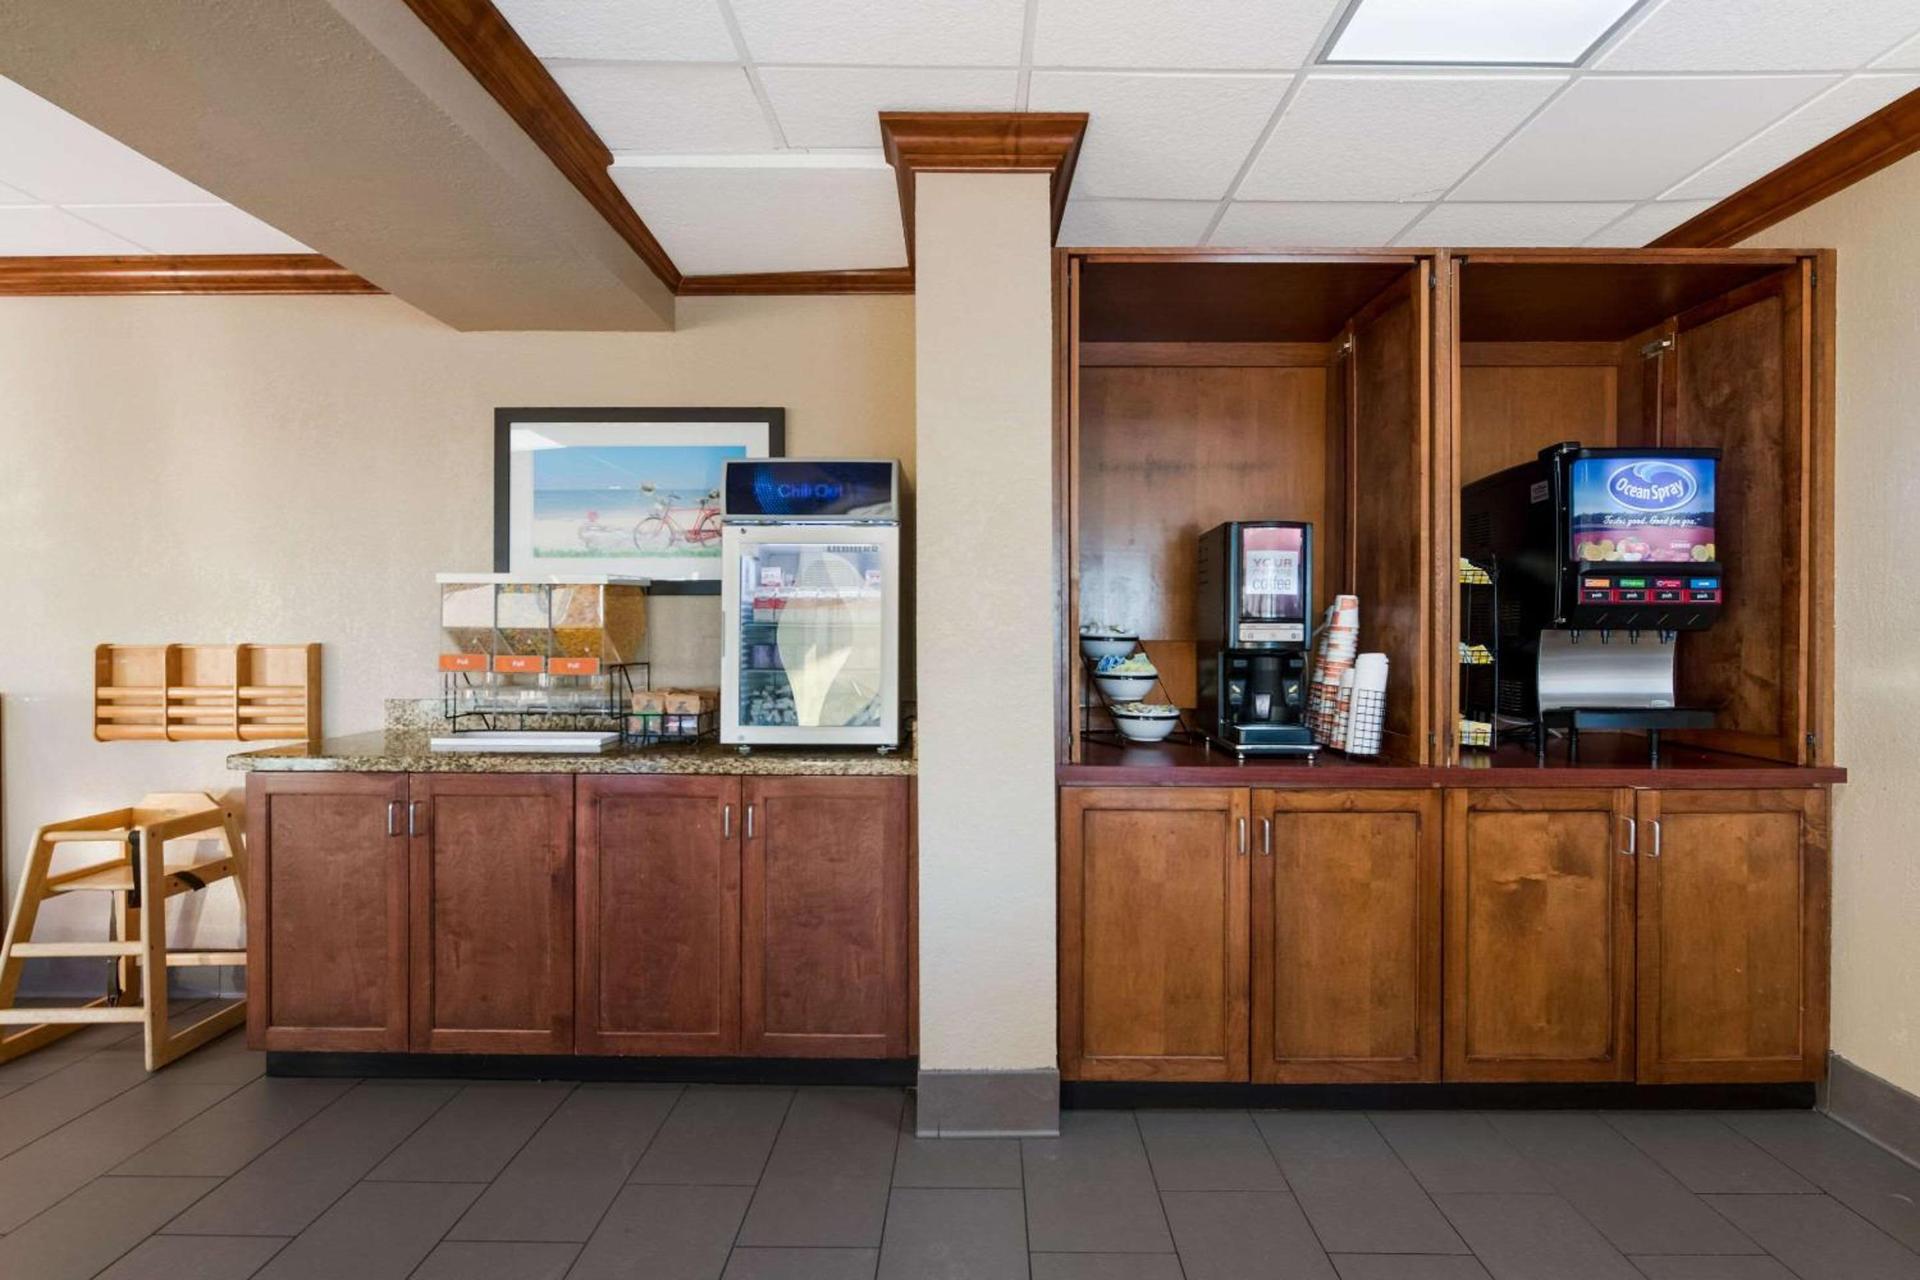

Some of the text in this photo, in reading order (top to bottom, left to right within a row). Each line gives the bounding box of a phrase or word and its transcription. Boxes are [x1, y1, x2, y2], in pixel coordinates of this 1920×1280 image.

[777, 483, 844, 498] Chill Out
[1615, 477, 1684, 502] Ocean Spray
